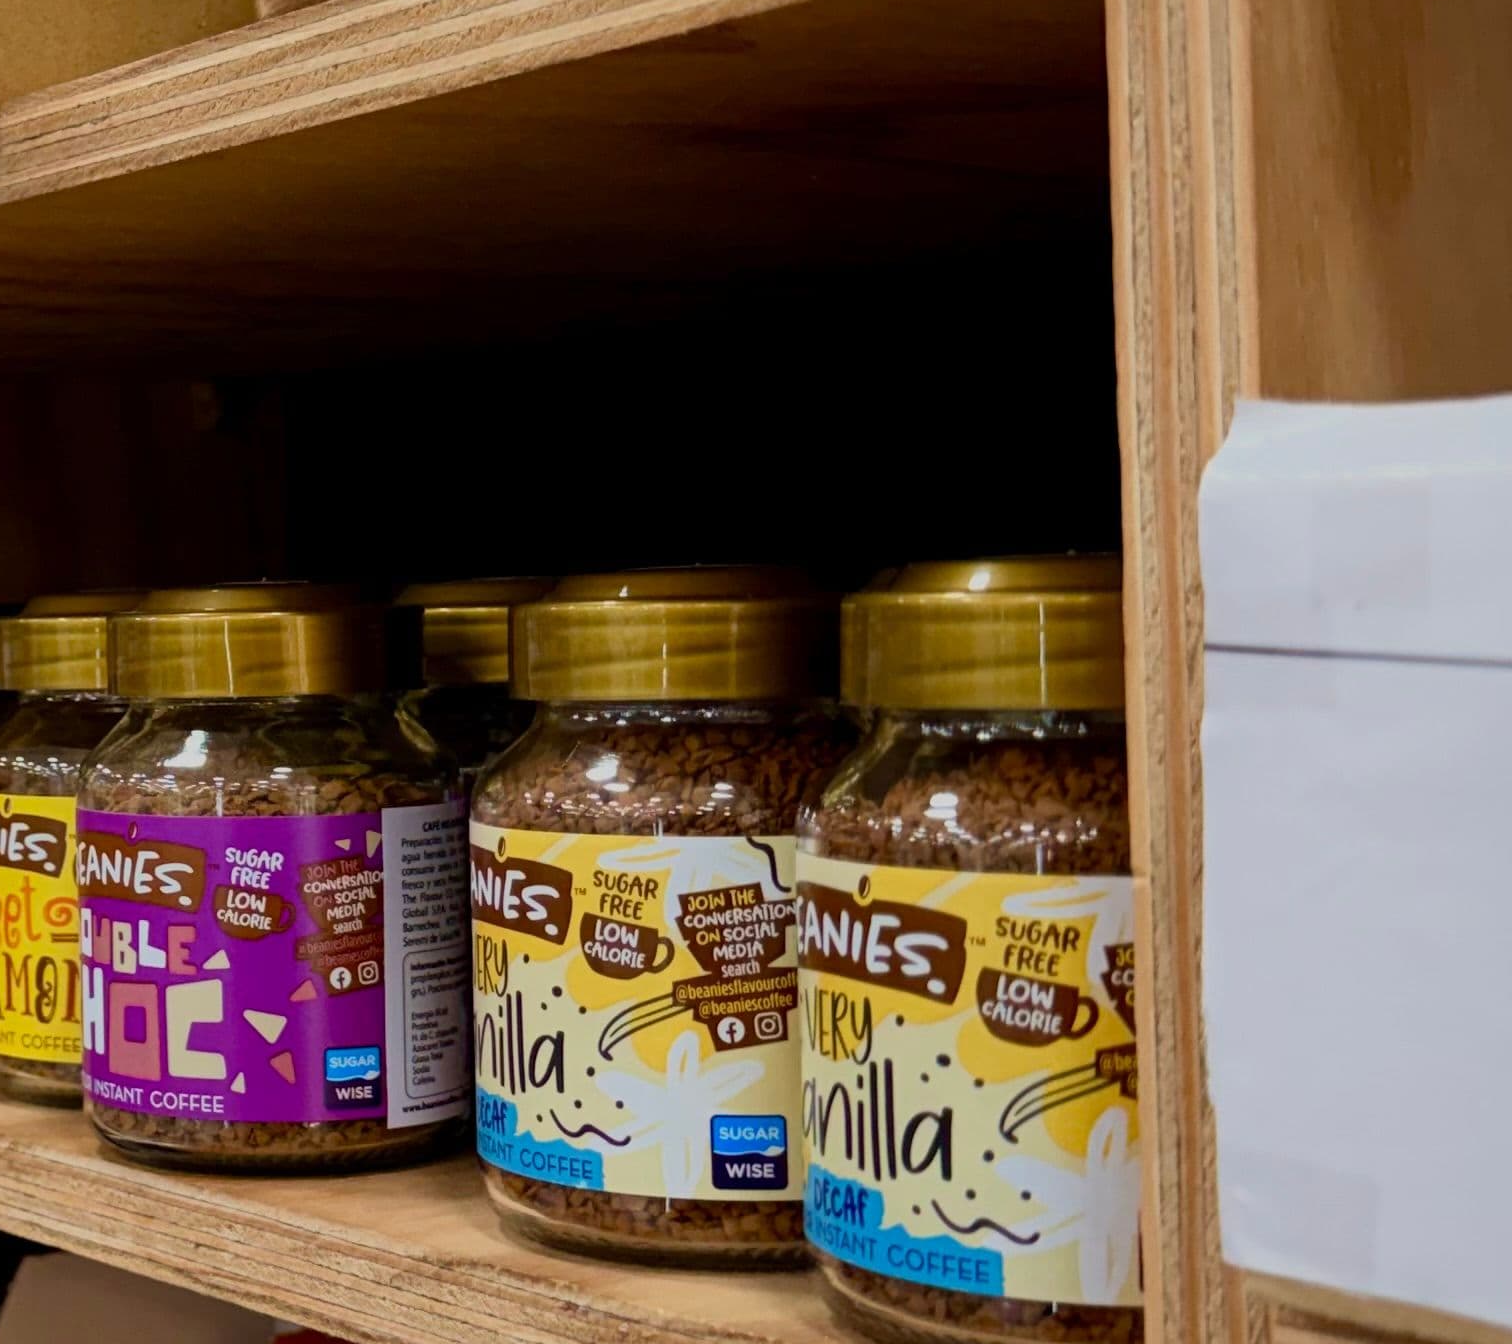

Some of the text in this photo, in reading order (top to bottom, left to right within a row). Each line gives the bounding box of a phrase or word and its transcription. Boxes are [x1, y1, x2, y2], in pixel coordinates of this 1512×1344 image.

[225, 846, 284, 872] SUGAR
[230, 869, 272, 891] FREE
[307, 865, 337, 879] JOIN
[334, 886, 377, 904] SOCIAL
[593, 870, 659, 901] SUGAR
[226, 891, 267, 913] LOW
[326, 902, 367, 921] MEDIA
[599, 893, 644, 920] FREE
[687, 888, 757, 912] JOIN THE
[216, 908, 273, 931] CALORIE
[332, 918, 364, 935] search
[684, 904, 796, 928] CONVERSATION
[595, 919, 639, 947] LOW
[696, 922, 779, 946] ON SOCIAL
[995, 917, 1081, 953] SUGAR
[584, 941, 646, 969] CALORIE
[713, 941, 764, 962] MEDIA
[1003, 943, 1061, 977] FREE
[721, 959, 761, 978] search
[996, 974, 1055, 1009] LOW
[699, 992, 793, 1019] @beaniescoffee
[982, 1000, 1062, 1035] CALORIE
[21, 1033, 81, 1053] COFFEE
[329, 1055, 376, 1070] SUGAR
[93, 1078, 225, 1113] INSTANT COFFEE
[335, 1086, 373, 1101] WISE
[719, 1125, 780, 1140] SUGAR
[519, 1147, 593, 1180] COFFEE
[725, 1164, 775, 1178] WISE
[813, 1177, 869, 1228] DECAF
[816, 1220, 990, 1283] INSTANT COFFEE
